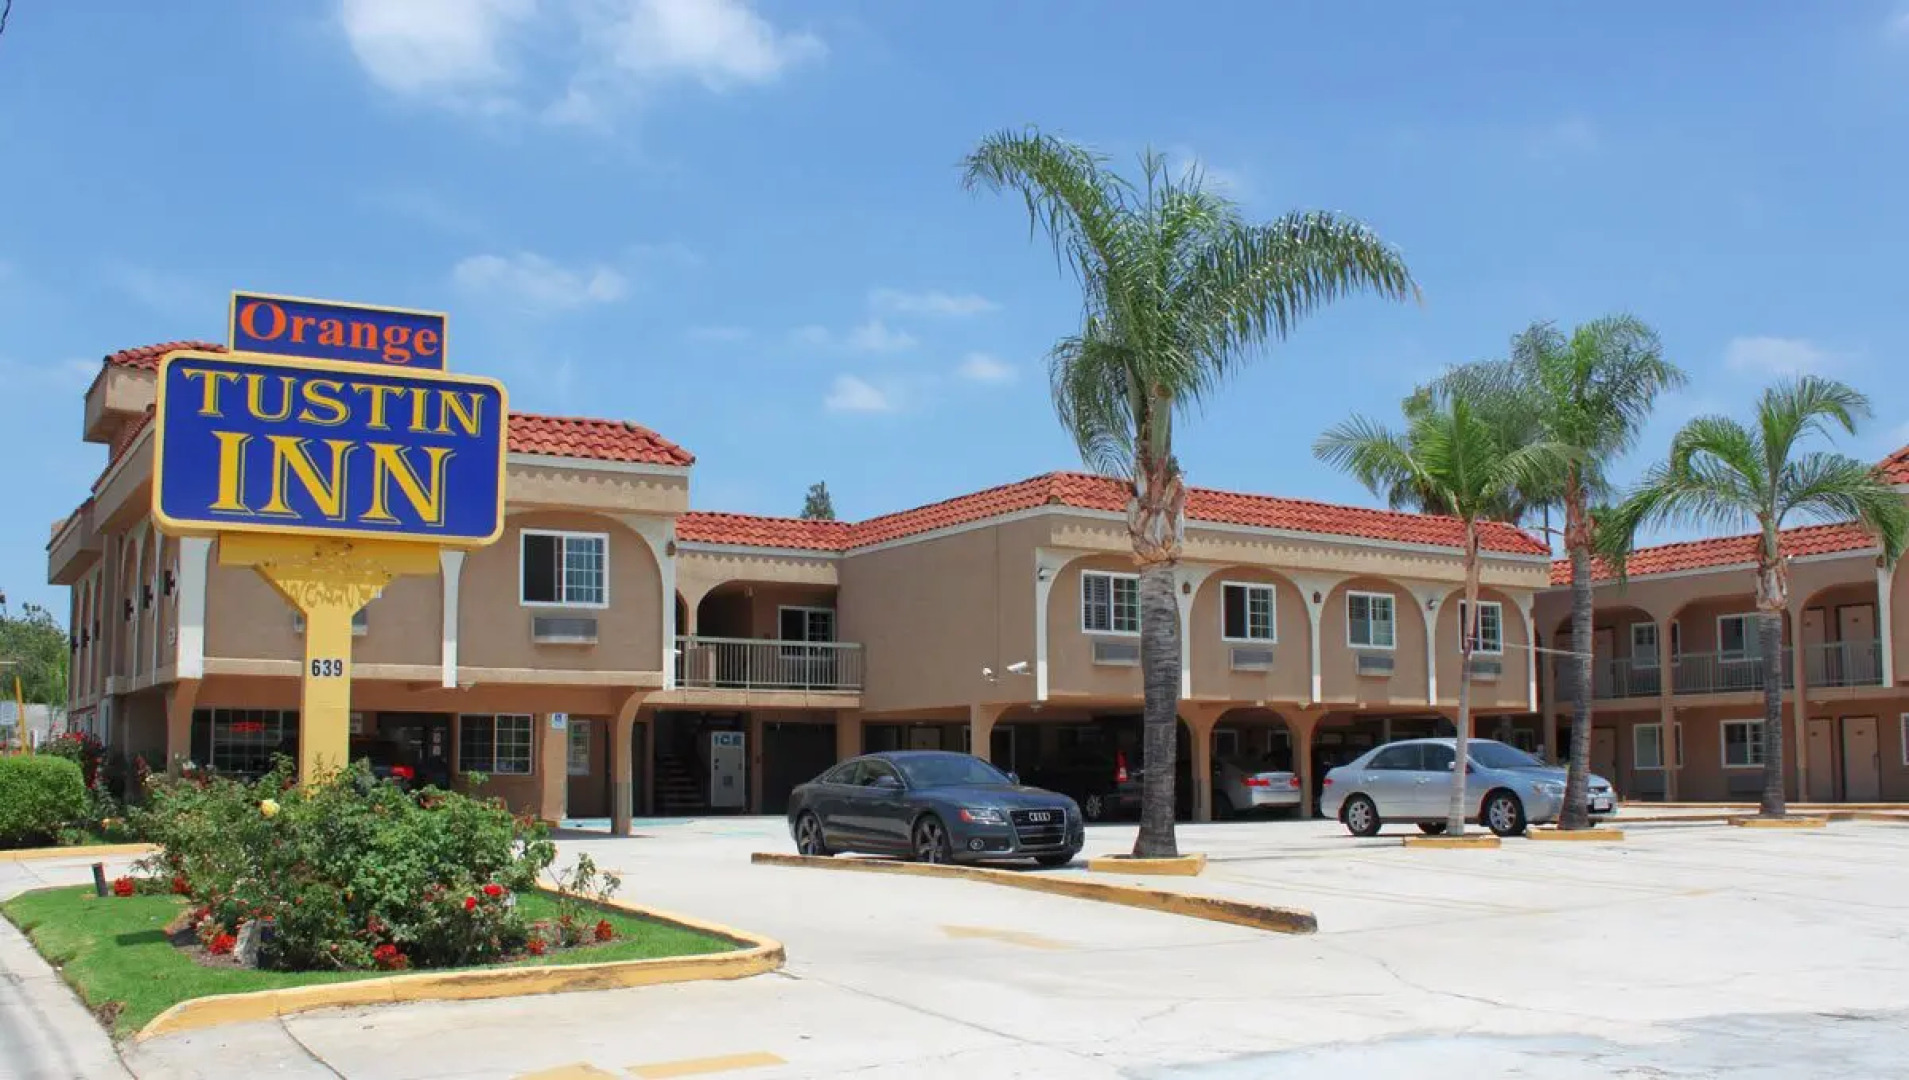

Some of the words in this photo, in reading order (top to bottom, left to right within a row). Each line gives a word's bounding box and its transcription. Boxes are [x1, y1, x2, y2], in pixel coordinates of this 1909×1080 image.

[240, 301, 439, 363] Orange
[182, 368, 485, 436] TUSTIN
[207, 430, 457, 527] INN
[311, 659, 343, 677] 639
[713, 735, 742, 746] ICE
